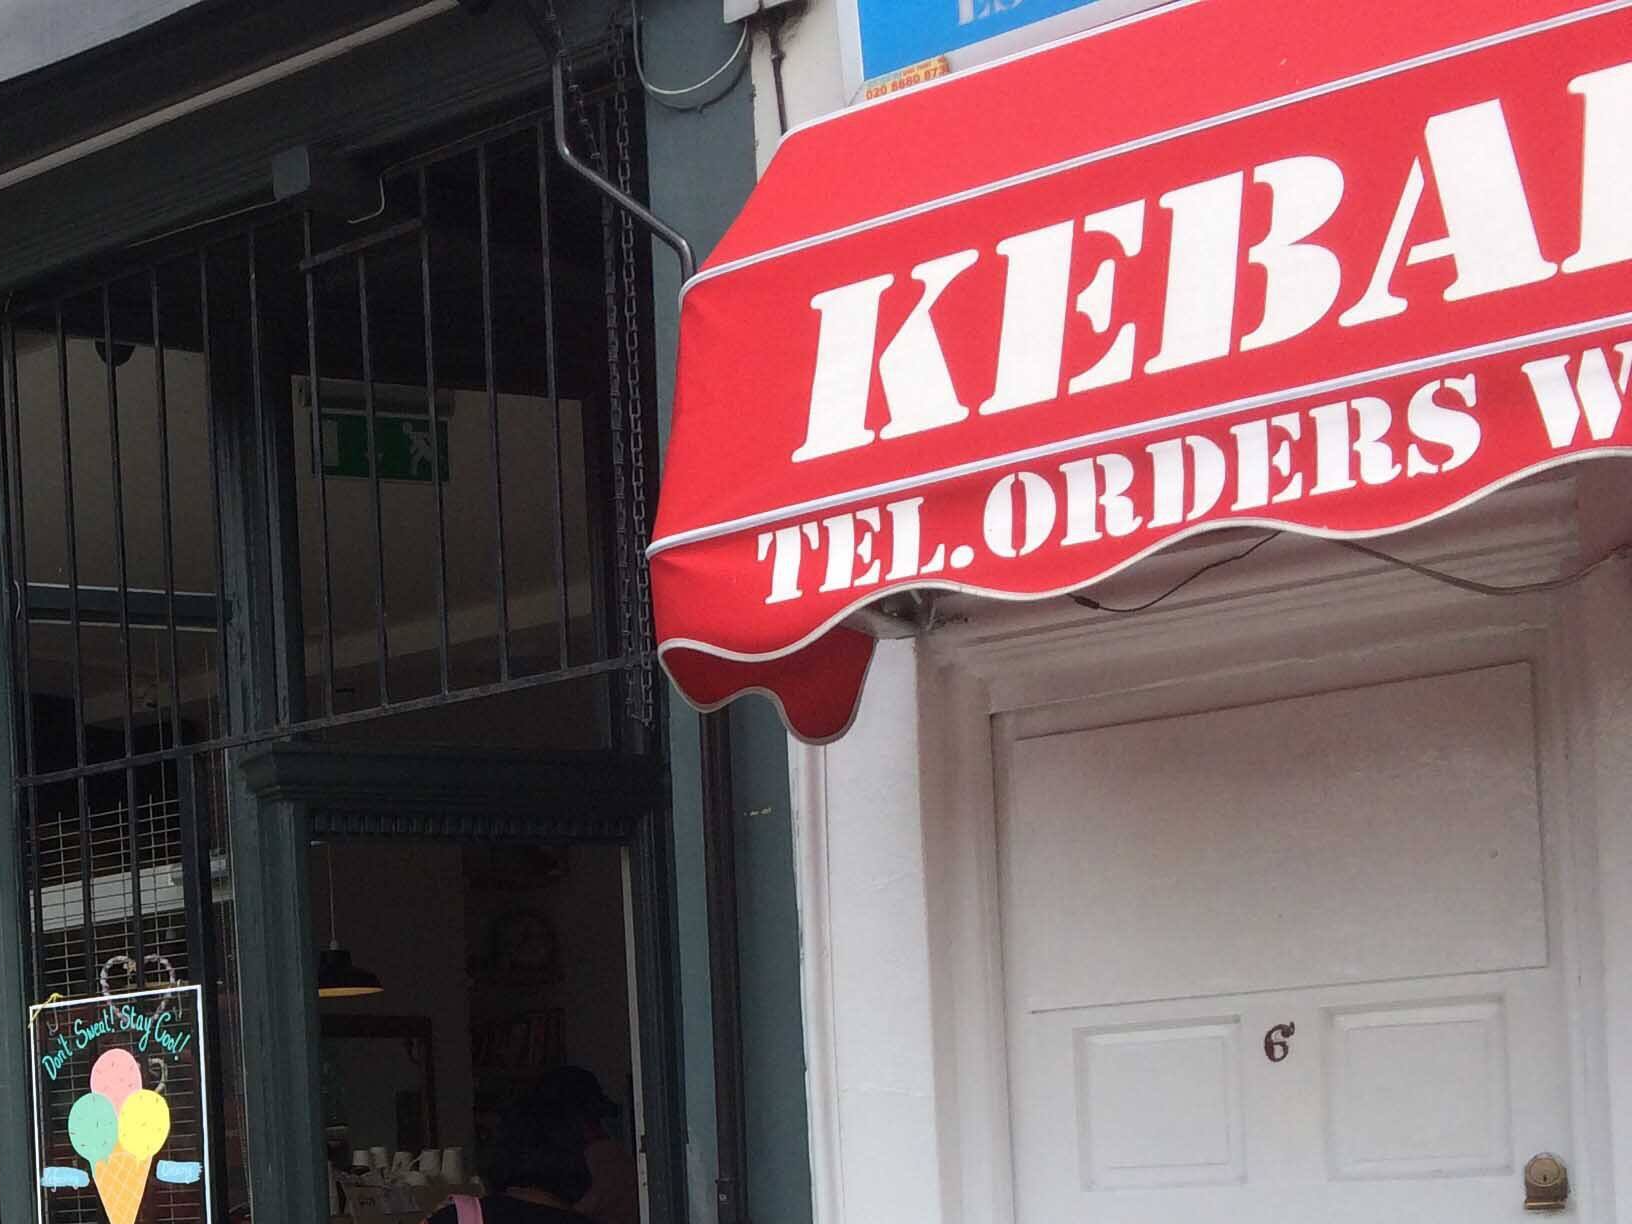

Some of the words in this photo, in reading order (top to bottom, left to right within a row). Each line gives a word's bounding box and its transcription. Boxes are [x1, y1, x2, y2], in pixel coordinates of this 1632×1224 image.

[42, 1034, 73, 1080] Don't
[74, 1005, 115, 1048] Sweat!
[120, 1004, 152, 1051] Stay
[1264, 1021, 1295, 1063] 6
